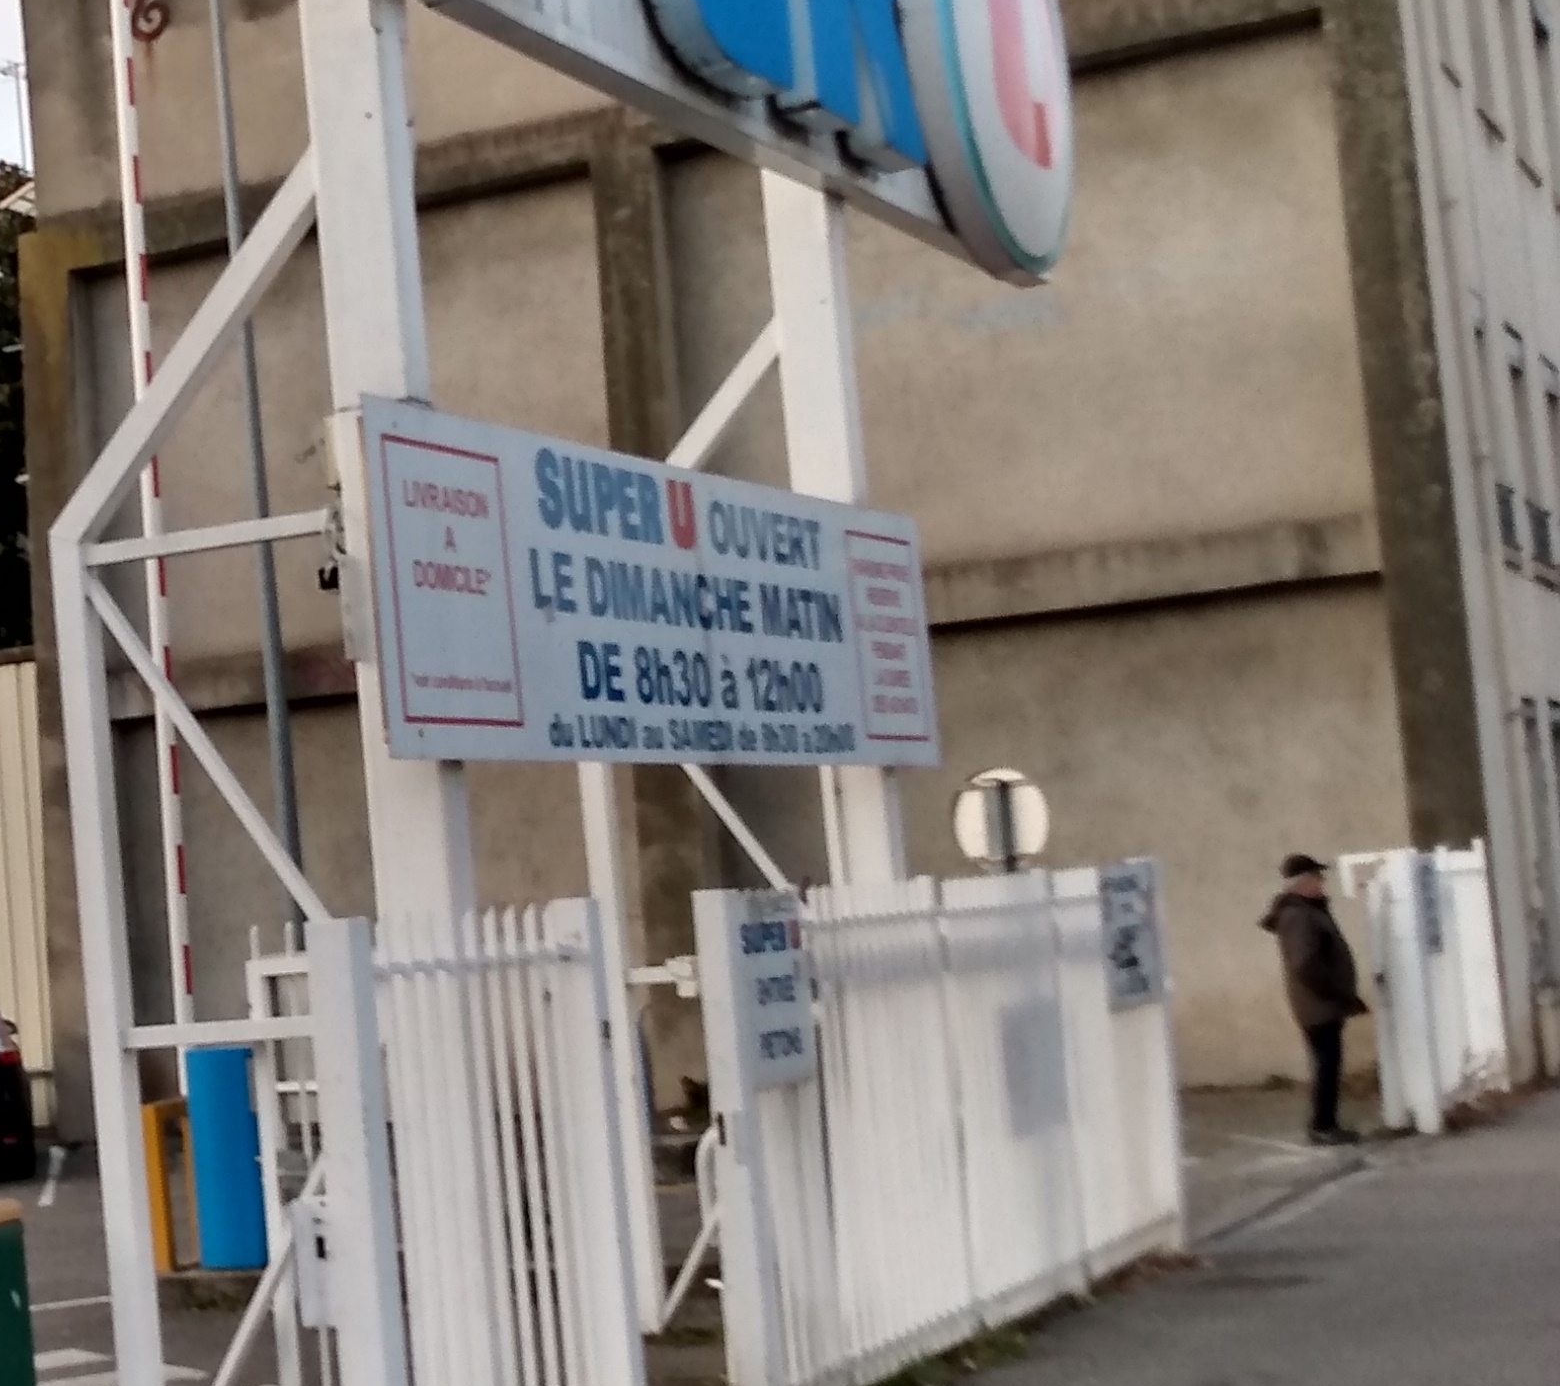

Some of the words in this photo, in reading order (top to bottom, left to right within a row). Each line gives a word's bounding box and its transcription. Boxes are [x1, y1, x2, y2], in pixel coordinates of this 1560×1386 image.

[401, 478, 490, 519] LIVRAISON
[534, 447, 665, 545] SUPER
[665, 478, 698, 550] U
[707, 499, 822, 570] OUVERT
[528, 546, 578, 613] LE
[585, 556, 754, 636] DIMANCHE
[758, 582, 844, 644] MATIN
[576, 639, 626, 703] DE
[633, 645, 712, 709] 8h30
[719, 653, 740, 710] à
[744, 656, 825, 714] 12h00
